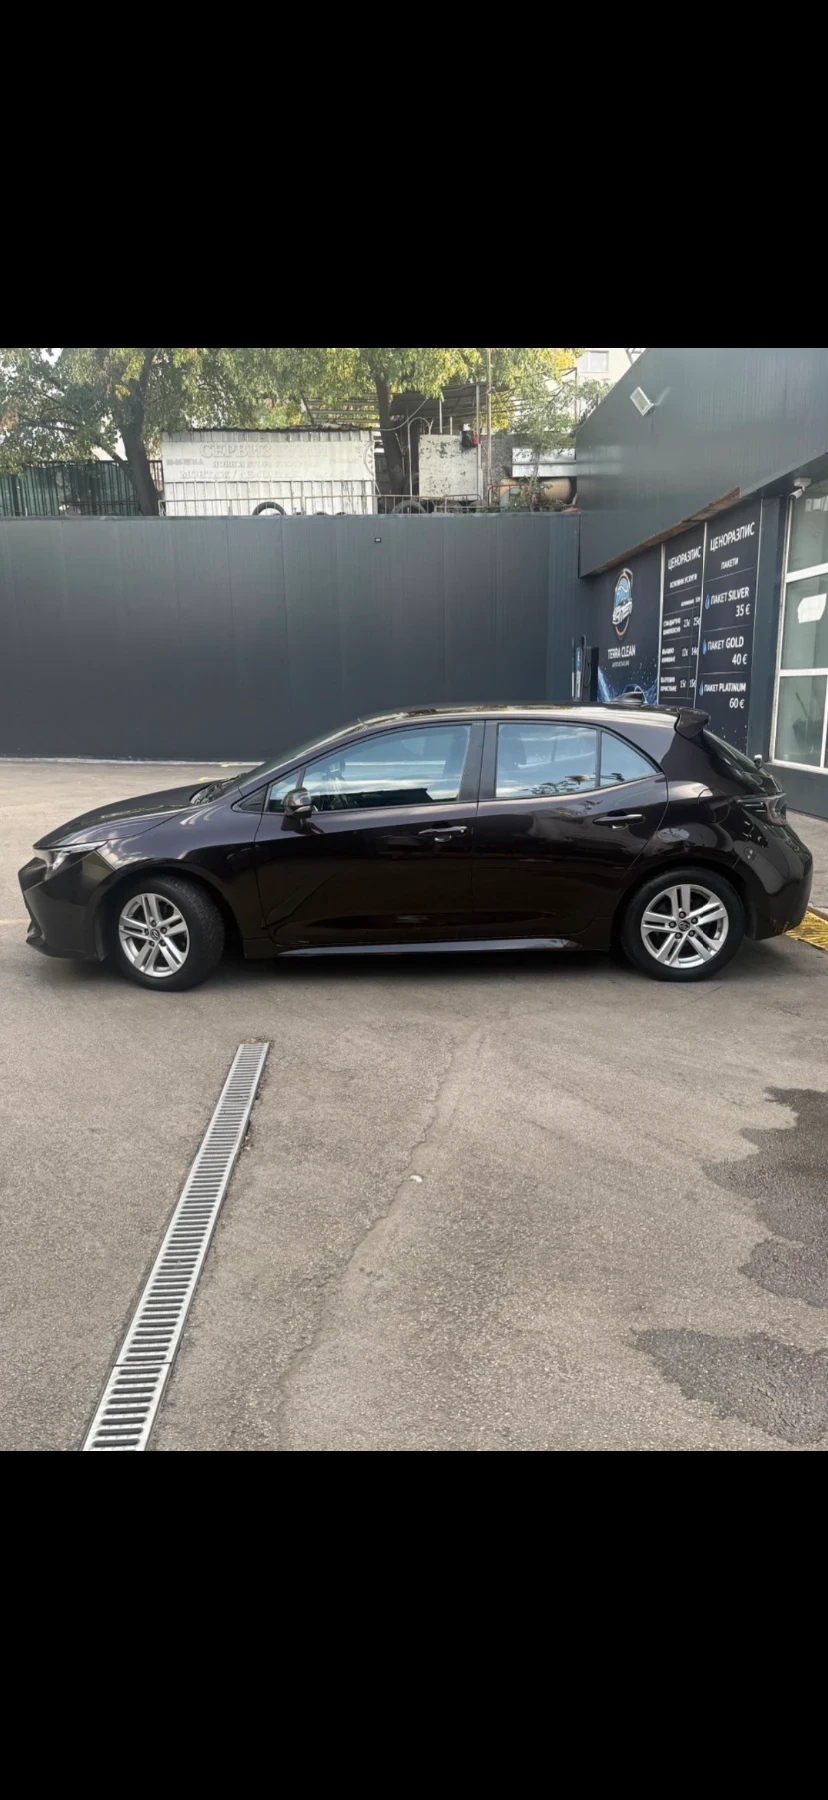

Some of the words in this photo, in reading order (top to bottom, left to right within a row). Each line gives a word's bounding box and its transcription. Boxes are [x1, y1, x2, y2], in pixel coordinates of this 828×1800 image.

[200, 443, 272, 458] СЕРВИЗ
[710, 521, 755, 552] ЦЕНОРАЗПИС
[668, 546, 702, 571] ЦЕНОРАЗПИС
[721, 557, 739, 570] ПАКЕТИ
[710, 592, 728, 605] ПАКЕТ
[728, 586, 750, 602] SILVER
[735, 605, 745, 617] 35
[745, 603, 751, 615] €
[707, 639, 725, 651] ПАКЕТ
[725, 636, 745, 649] GOLD
[607, 647, 621, 660] TERRA
[621, 644, 636, 658] CLEAN
[732, 654, 742, 666] 40
[742, 653, 748, 665] €
[704, 683, 719, 693] ПАКЕТ
[719, 682, 747, 692] PLATINUM
[729, 697, 739, 709] 60
[739, 699, 745, 709] €
